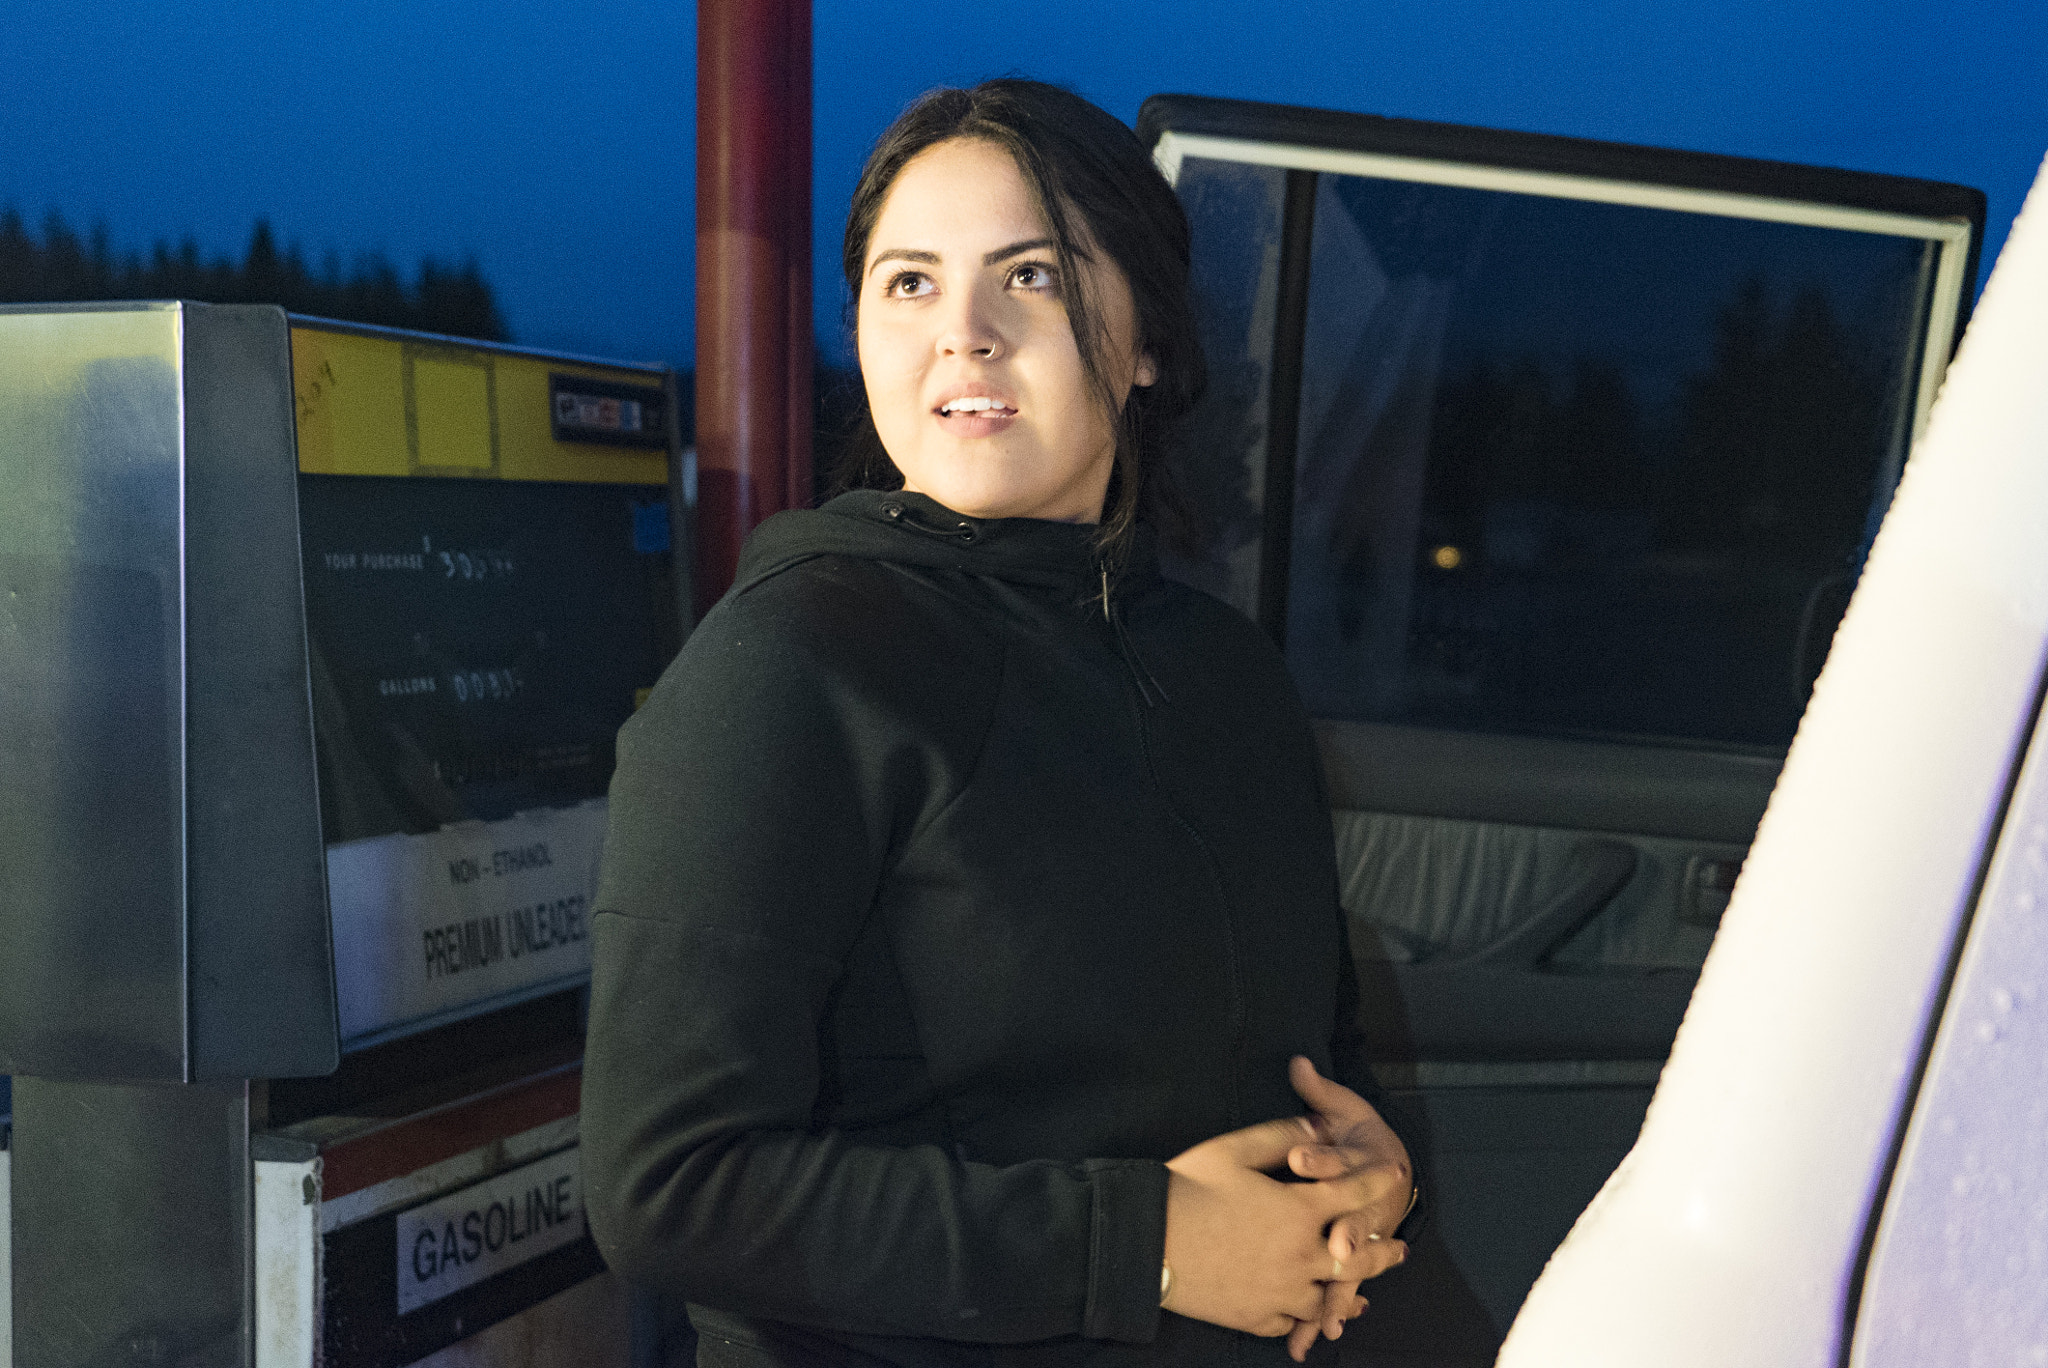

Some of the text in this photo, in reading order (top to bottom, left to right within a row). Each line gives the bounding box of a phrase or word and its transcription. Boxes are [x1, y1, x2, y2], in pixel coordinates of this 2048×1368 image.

[324, 552, 356, 569] YOUR
[362, 552, 423, 569] PURCHASE
[380, 677, 436, 697] GALLONS
[424, 915, 503, 980] PREMIUM
[413, 1176, 571, 1282] GASOLINE
